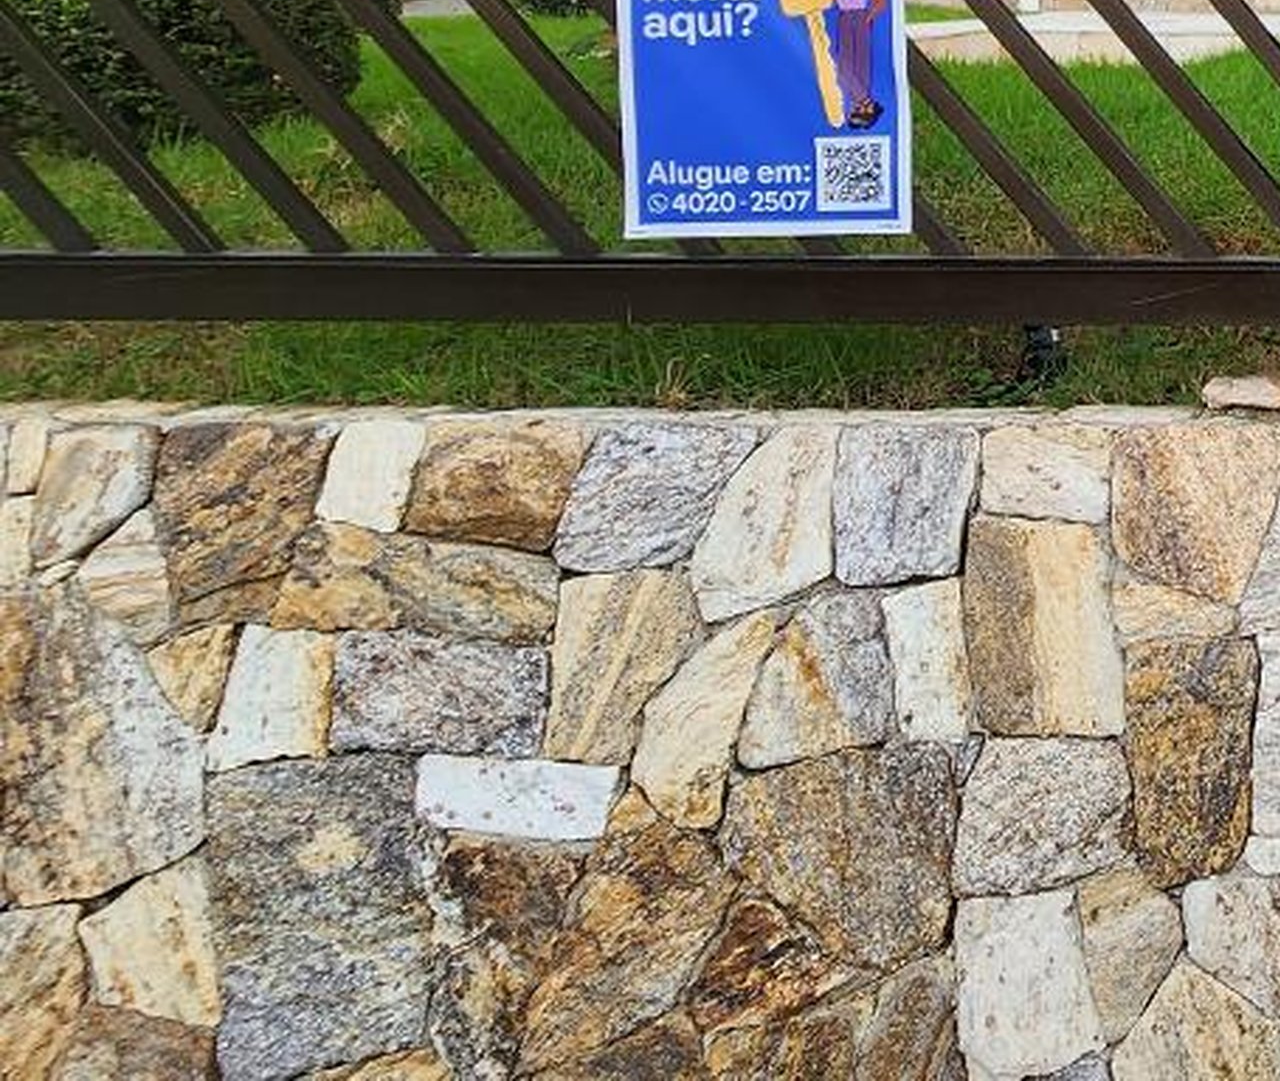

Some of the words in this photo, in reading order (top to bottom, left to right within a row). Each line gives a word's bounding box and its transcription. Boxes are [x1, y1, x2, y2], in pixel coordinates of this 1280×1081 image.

[643, 2, 758, 46] aqui?
[646, 160, 750, 189] Alugue
[756, 163, 812, 184] em:
